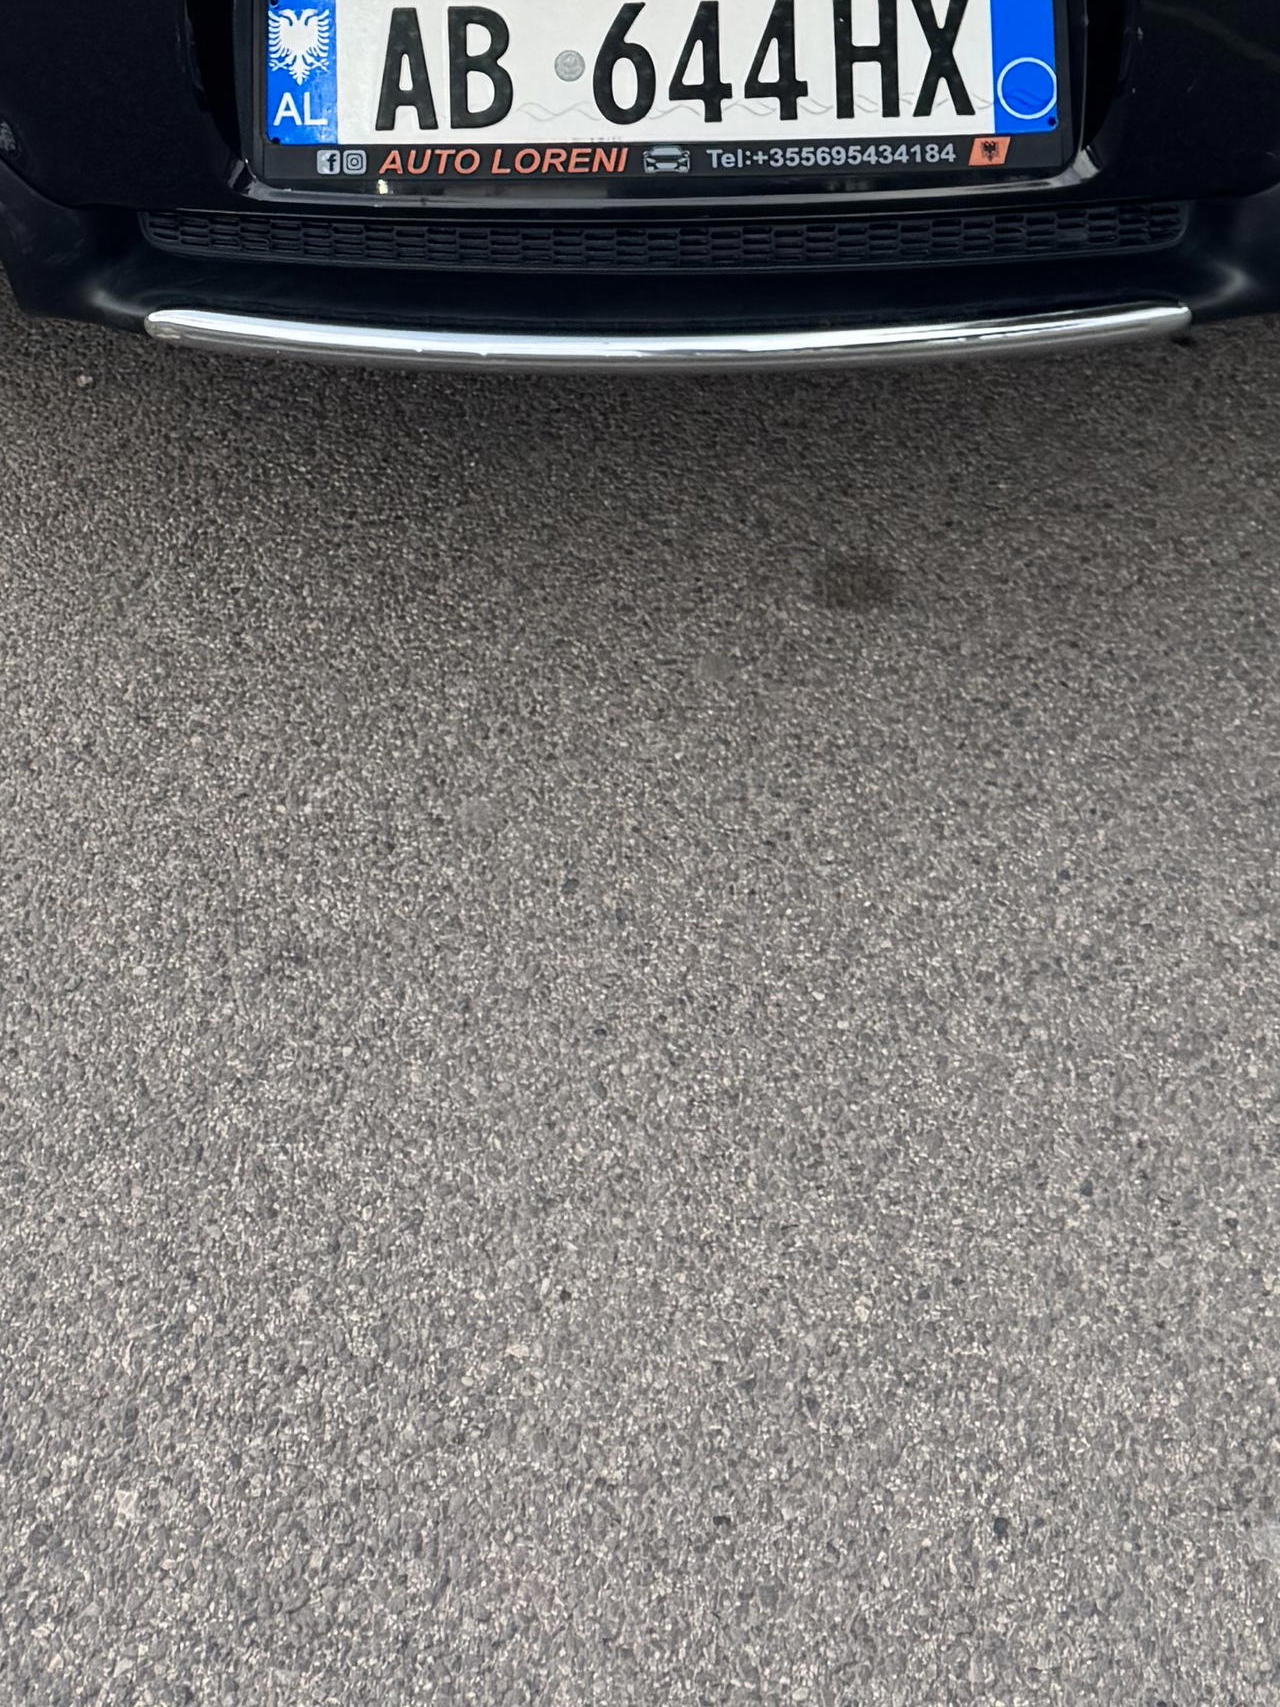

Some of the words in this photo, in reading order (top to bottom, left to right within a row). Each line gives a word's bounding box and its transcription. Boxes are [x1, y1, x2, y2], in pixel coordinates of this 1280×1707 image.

[375, 5, 514, 131] AB
[273, 91, 328, 128] AL
[378, 149, 481, 175] AUTO
[491, 147, 629, 175] LORENI
